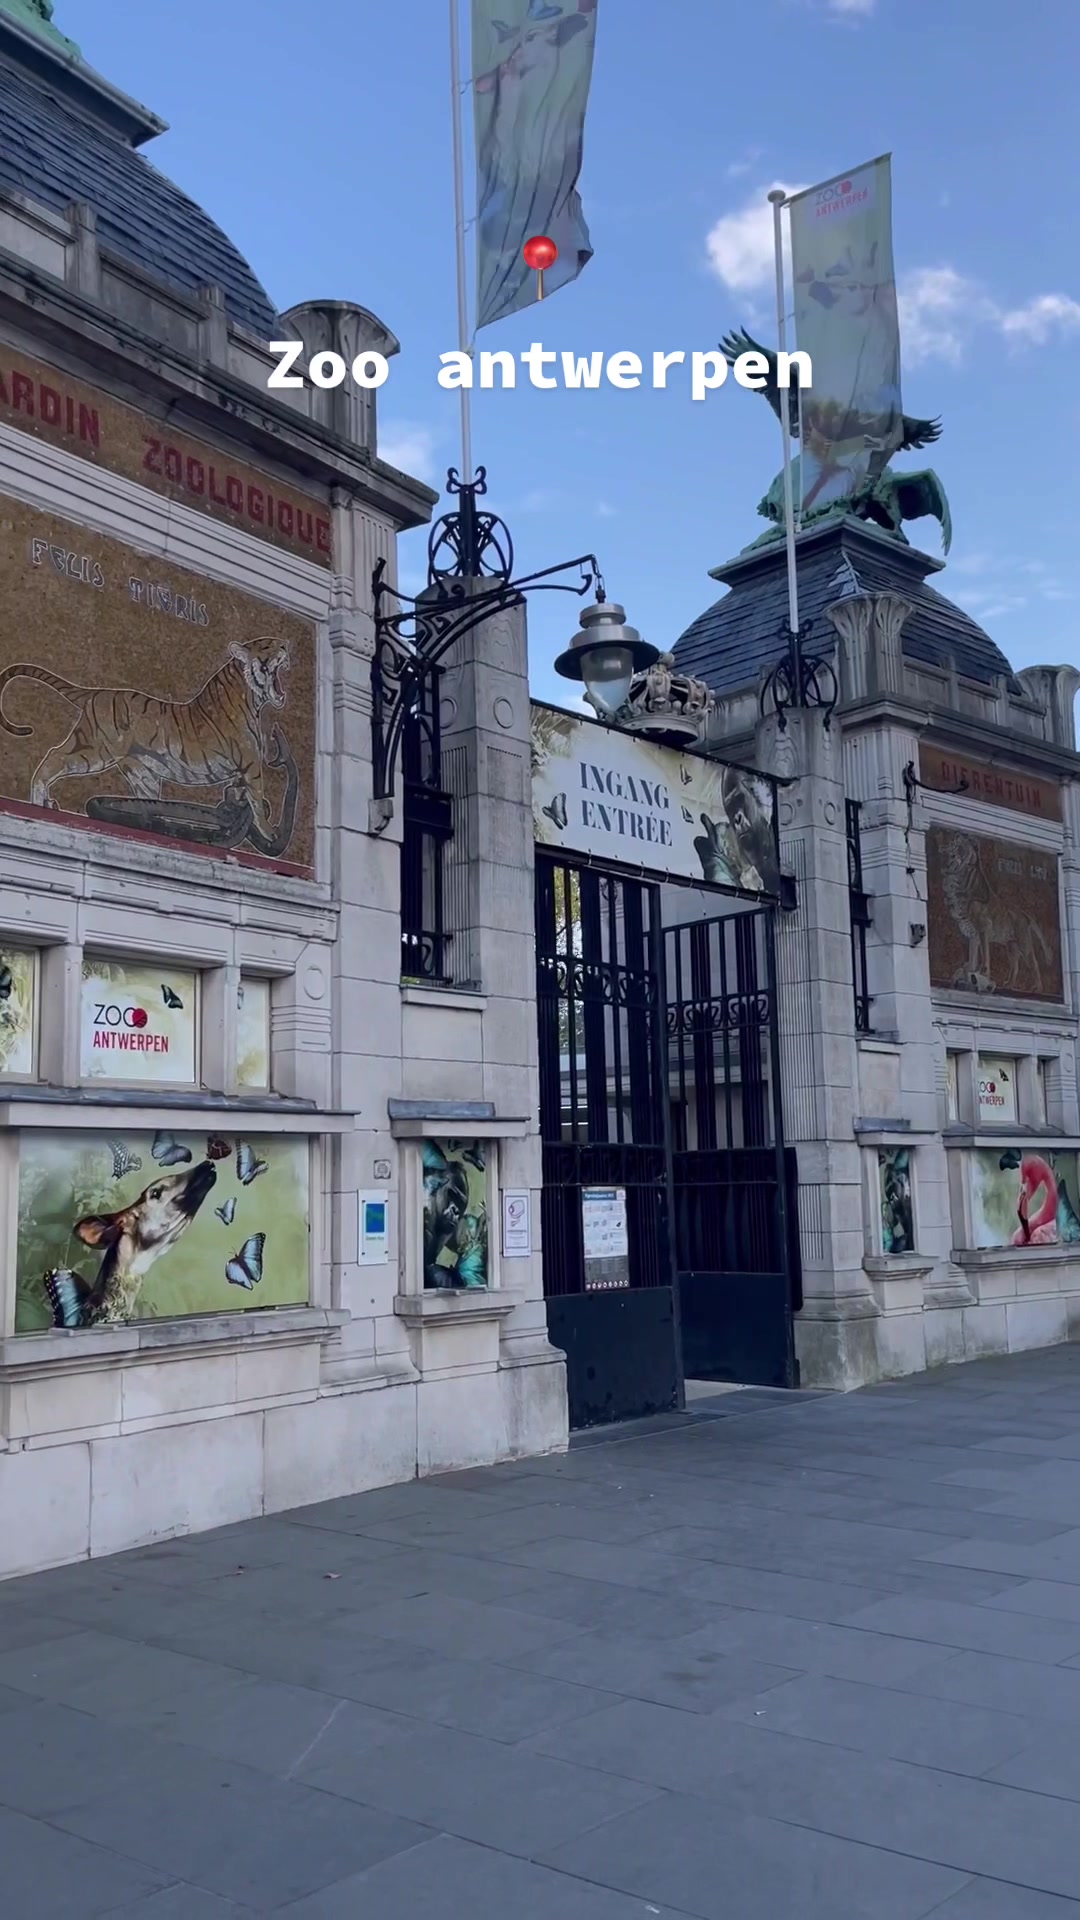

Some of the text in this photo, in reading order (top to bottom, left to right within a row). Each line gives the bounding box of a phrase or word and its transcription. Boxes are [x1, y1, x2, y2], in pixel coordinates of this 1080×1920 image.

[142, 435, 331, 553] ZOOLOGIQUE
[32, 538, 209, 626] FELIS TIGRIS
[579, 762, 670, 809] INGANG
[941, 761, 1042, 809] DIERENTUIN
[581, 800, 673, 847] ENTRÉE
[93, 1003, 147, 1028] ZOO
[93, 1030, 169, 1053] ANTWERPEN
